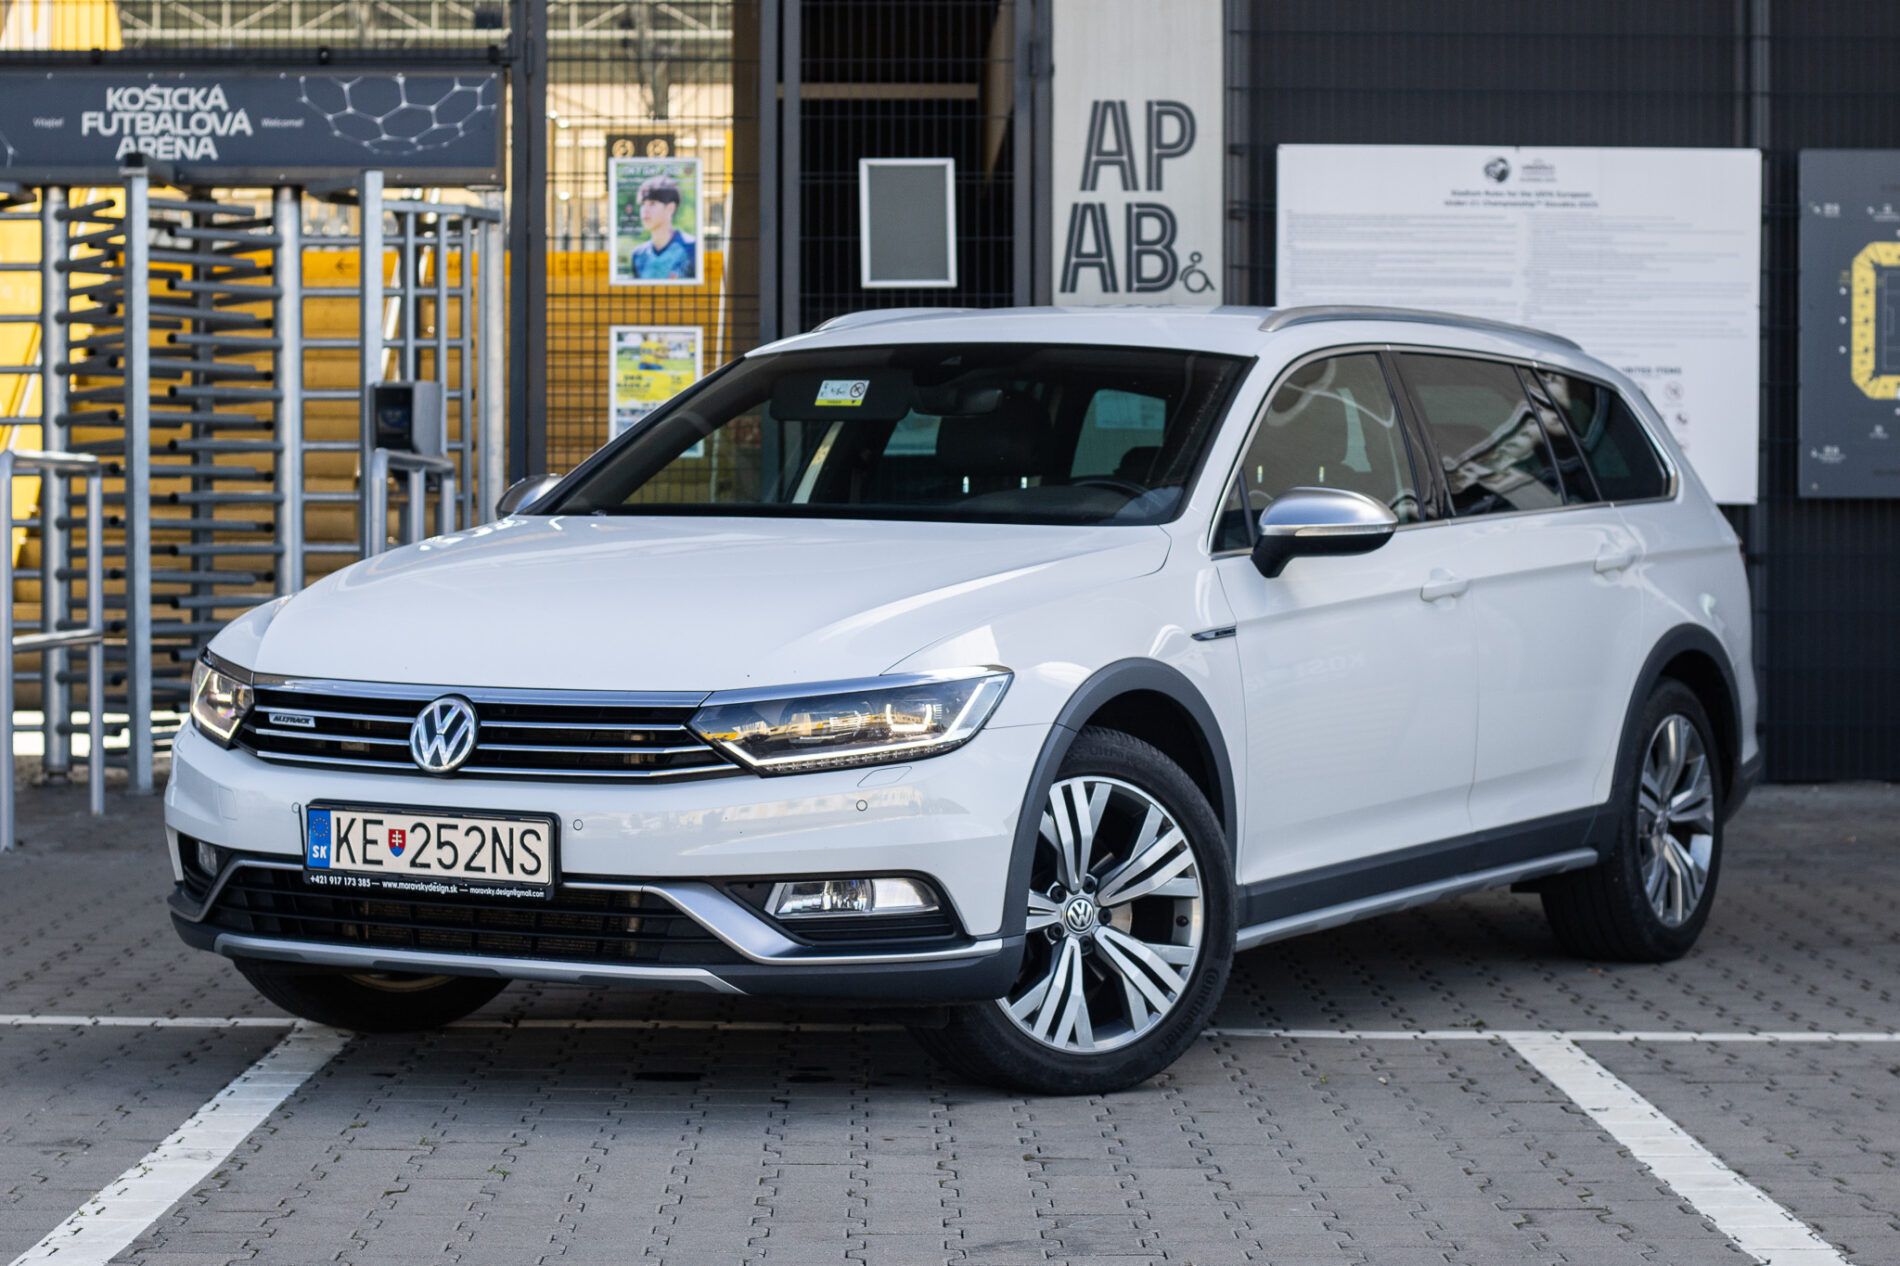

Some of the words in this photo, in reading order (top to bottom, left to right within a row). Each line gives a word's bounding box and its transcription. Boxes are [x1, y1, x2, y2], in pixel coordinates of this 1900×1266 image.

[82, 108, 253, 136] FUTBALOVÁ
[1080, 100, 1196, 191] AP
[1059, 203, 1179, 293] AB
[273, 715, 311, 725] ALLTRACK
[312, 846, 328, 859] SK
[335, 817, 384, 866] KE
[409, 822, 542, 876] 252NS
[310, 875, 327, 885] +421
[329, 876, 342, 885] 917
[344, 877, 357, 887] 173
[358, 878, 371, 888] 385
[382, 880, 458, 894] www.moravskydesign.sk
